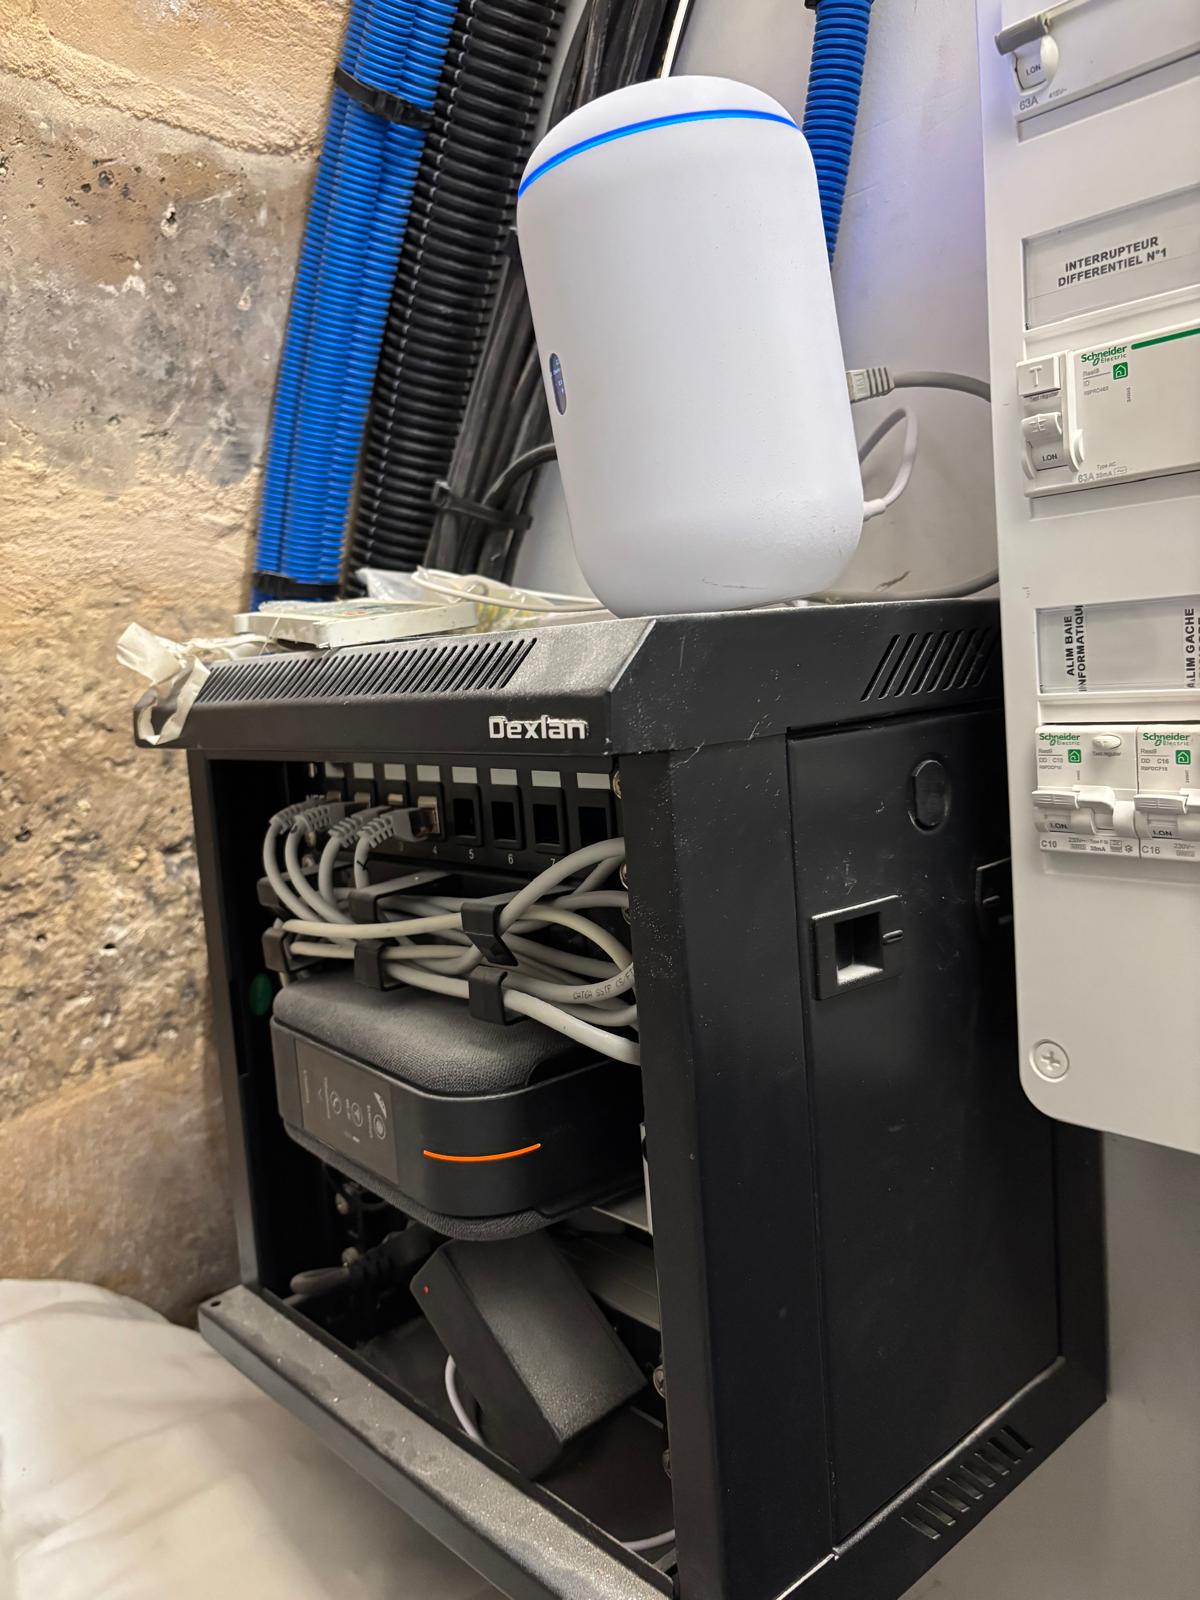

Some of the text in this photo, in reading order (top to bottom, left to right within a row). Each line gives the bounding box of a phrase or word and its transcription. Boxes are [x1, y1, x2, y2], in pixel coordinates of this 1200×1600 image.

[1019, 95, 1039, 111] 63A
[1065, 235, 1159, 273] INTERRUPTEUR
[1057, 247, 1167, 288] DIFFERENTIEL N°1
[1080, 345, 1128, 363] Schneider
[1100, 353, 1127, 364] Electric
[1077, 471, 1095, 483] 63A
[1063, 615, 1075, 676] ALIM BAIE
[1185, 608, 1196, 688] ALIM GACHE
[1038, 732, 1080, 741] Schneider
[1142, 732, 1190, 741] Schneider
[1040, 839, 1058, 849] C10
[468, 848, 475, 860] 5
[1141, 846, 1161, 855] C16
[507, 853, 514, 865] 6
